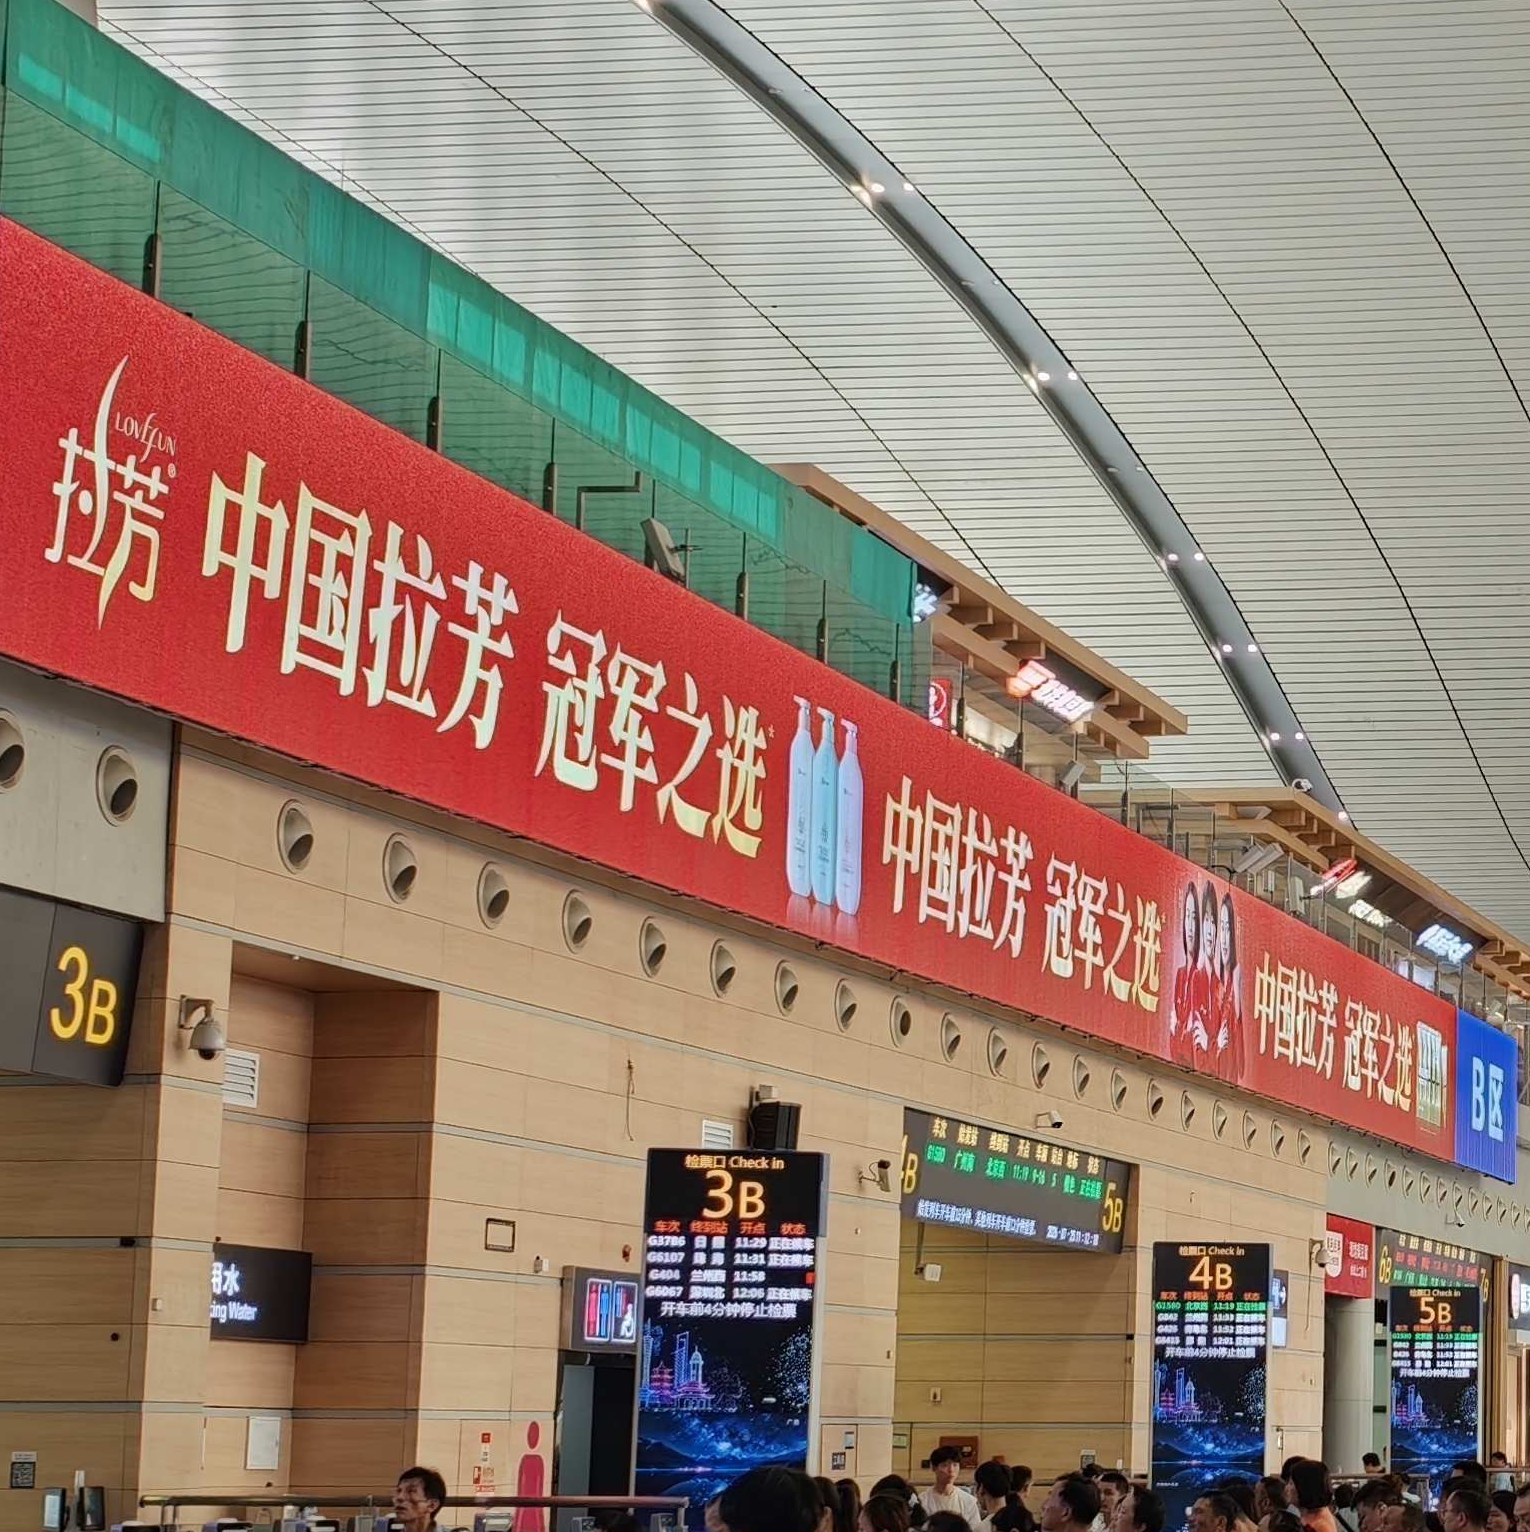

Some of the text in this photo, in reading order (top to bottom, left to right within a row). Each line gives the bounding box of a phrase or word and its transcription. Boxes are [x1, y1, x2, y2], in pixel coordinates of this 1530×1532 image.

[202, 451, 769, 858] 中国拉芳 冠军之选
[882, 774, 1162, 1013] 中国拉芳 冠军之选
[49, 944, 119, 1046] 3B
[1253, 951, 1413, 1113] 中国拉芳 冠军之选
[1472, 1055, 1506, 1144] B区
[685, 1154, 785, 1169] 检票口 Check in
[702, 1169, 766, 1219] 3B
[1101, 1181, 1124, 1233] 5B
[653, 1220, 681, 1233] 车次
[740, 1222, 767, 1235] 开点
[1189, 1255, 1233, 1290] 4B
[1208, 1246, 1234, 1255] Check
[1379, 1244, 1392, 1283] 6B
[228, 1302, 258, 1322] Water
[1419, 1296, 1452, 1324] 5B
